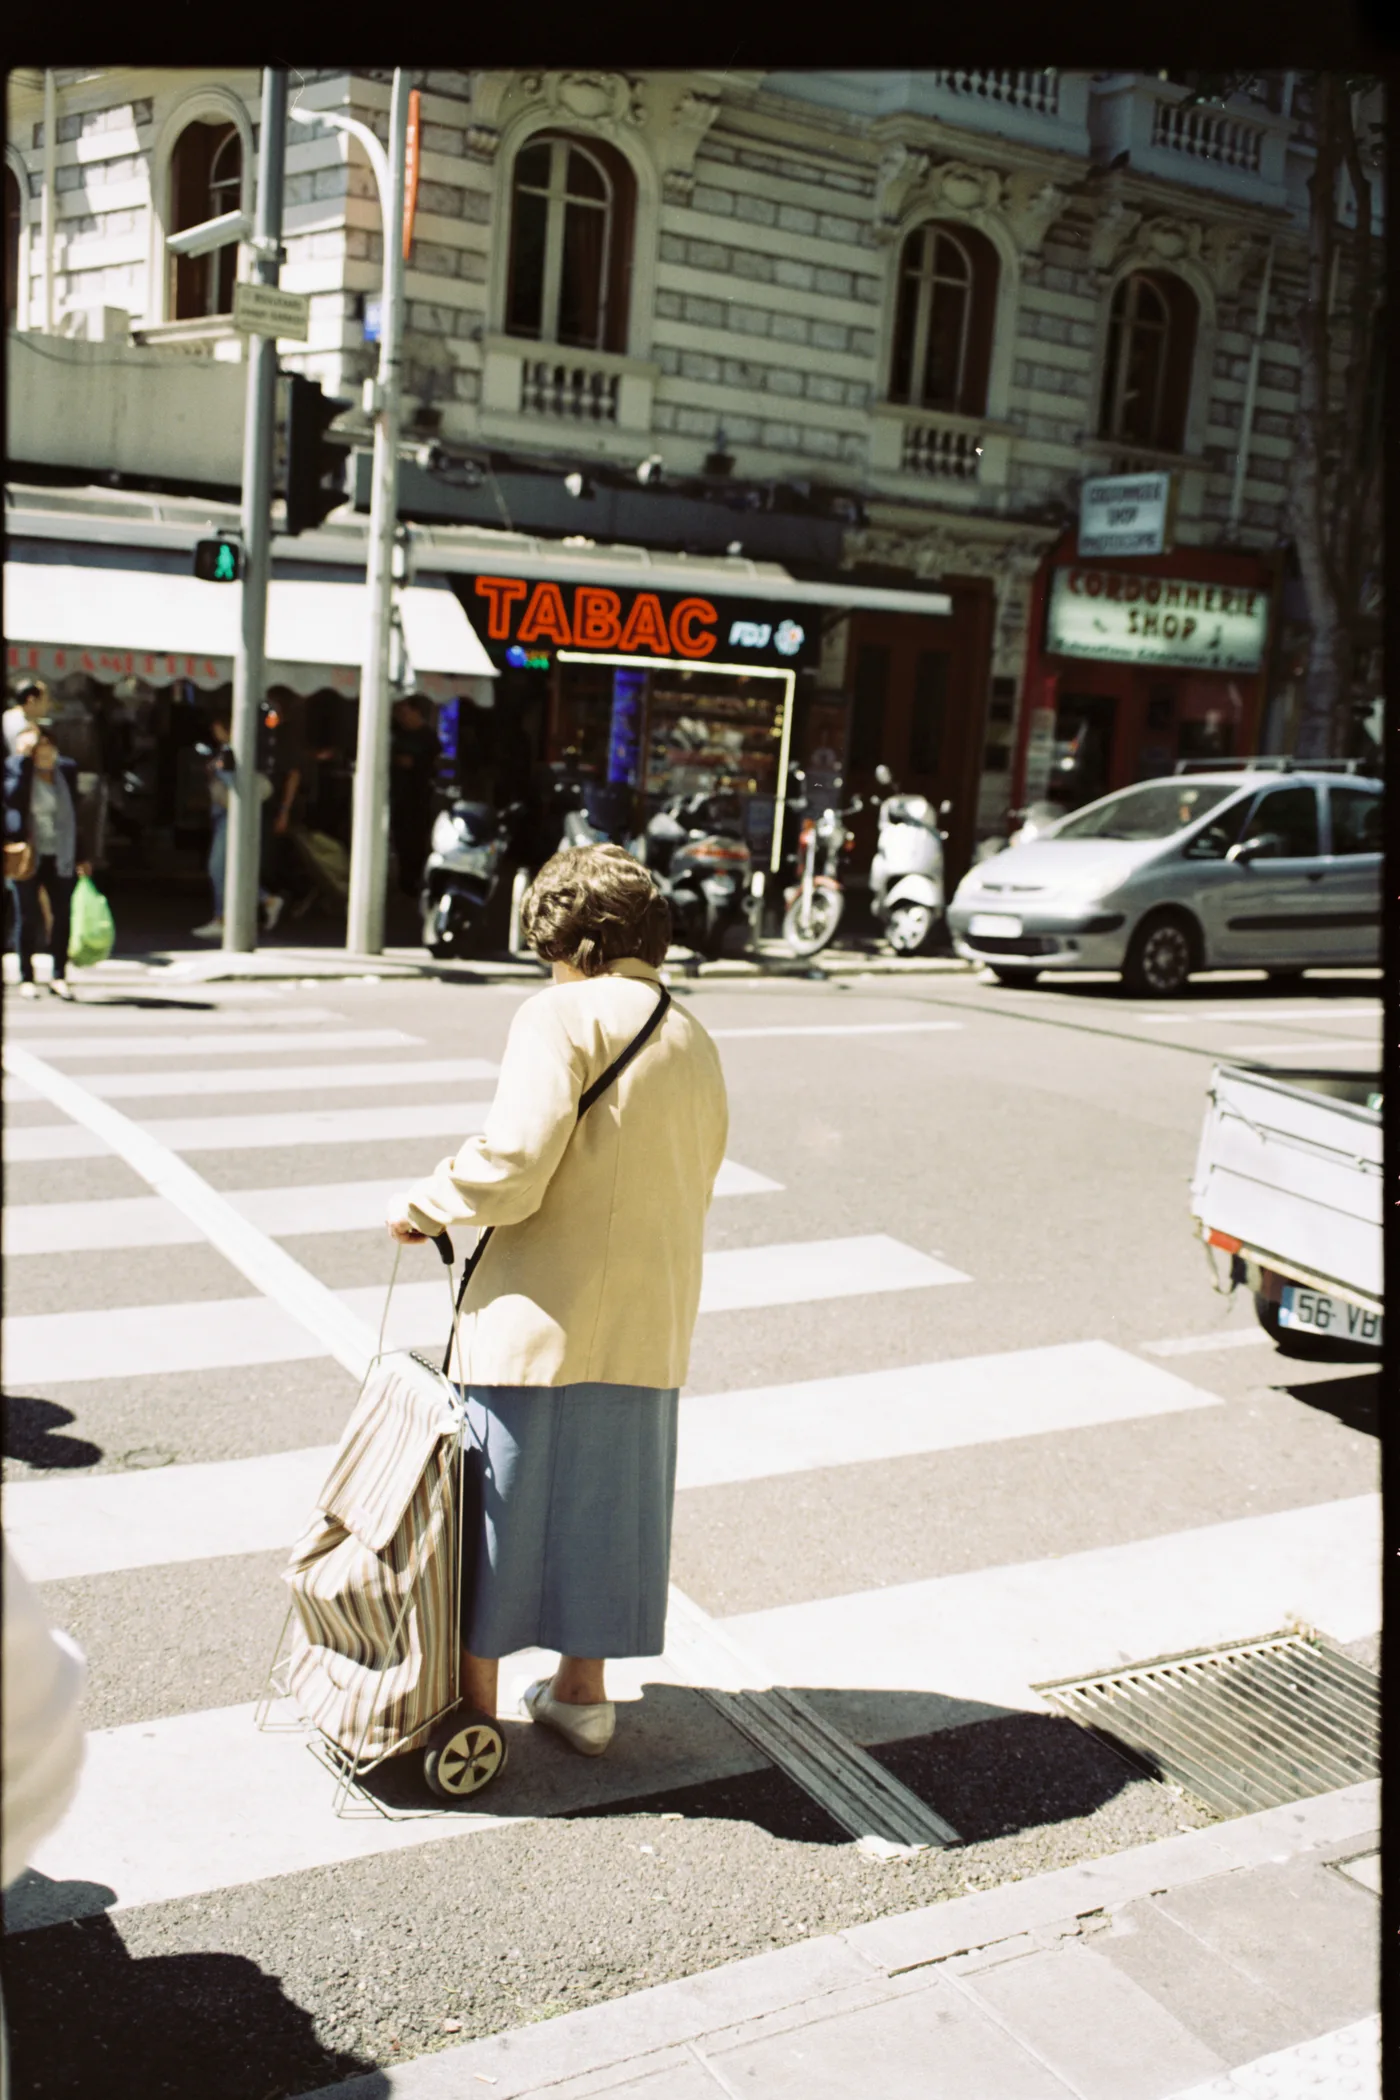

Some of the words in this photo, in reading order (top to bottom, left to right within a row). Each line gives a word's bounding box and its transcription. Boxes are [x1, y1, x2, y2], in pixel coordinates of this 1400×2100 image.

[1068, 570, 1258, 618] CORDONNERIE
[475, 575, 718, 658] TABAC
[1128, 608, 1197, 641] SHOP
[1299, 1294, 1333, 1328] 56
